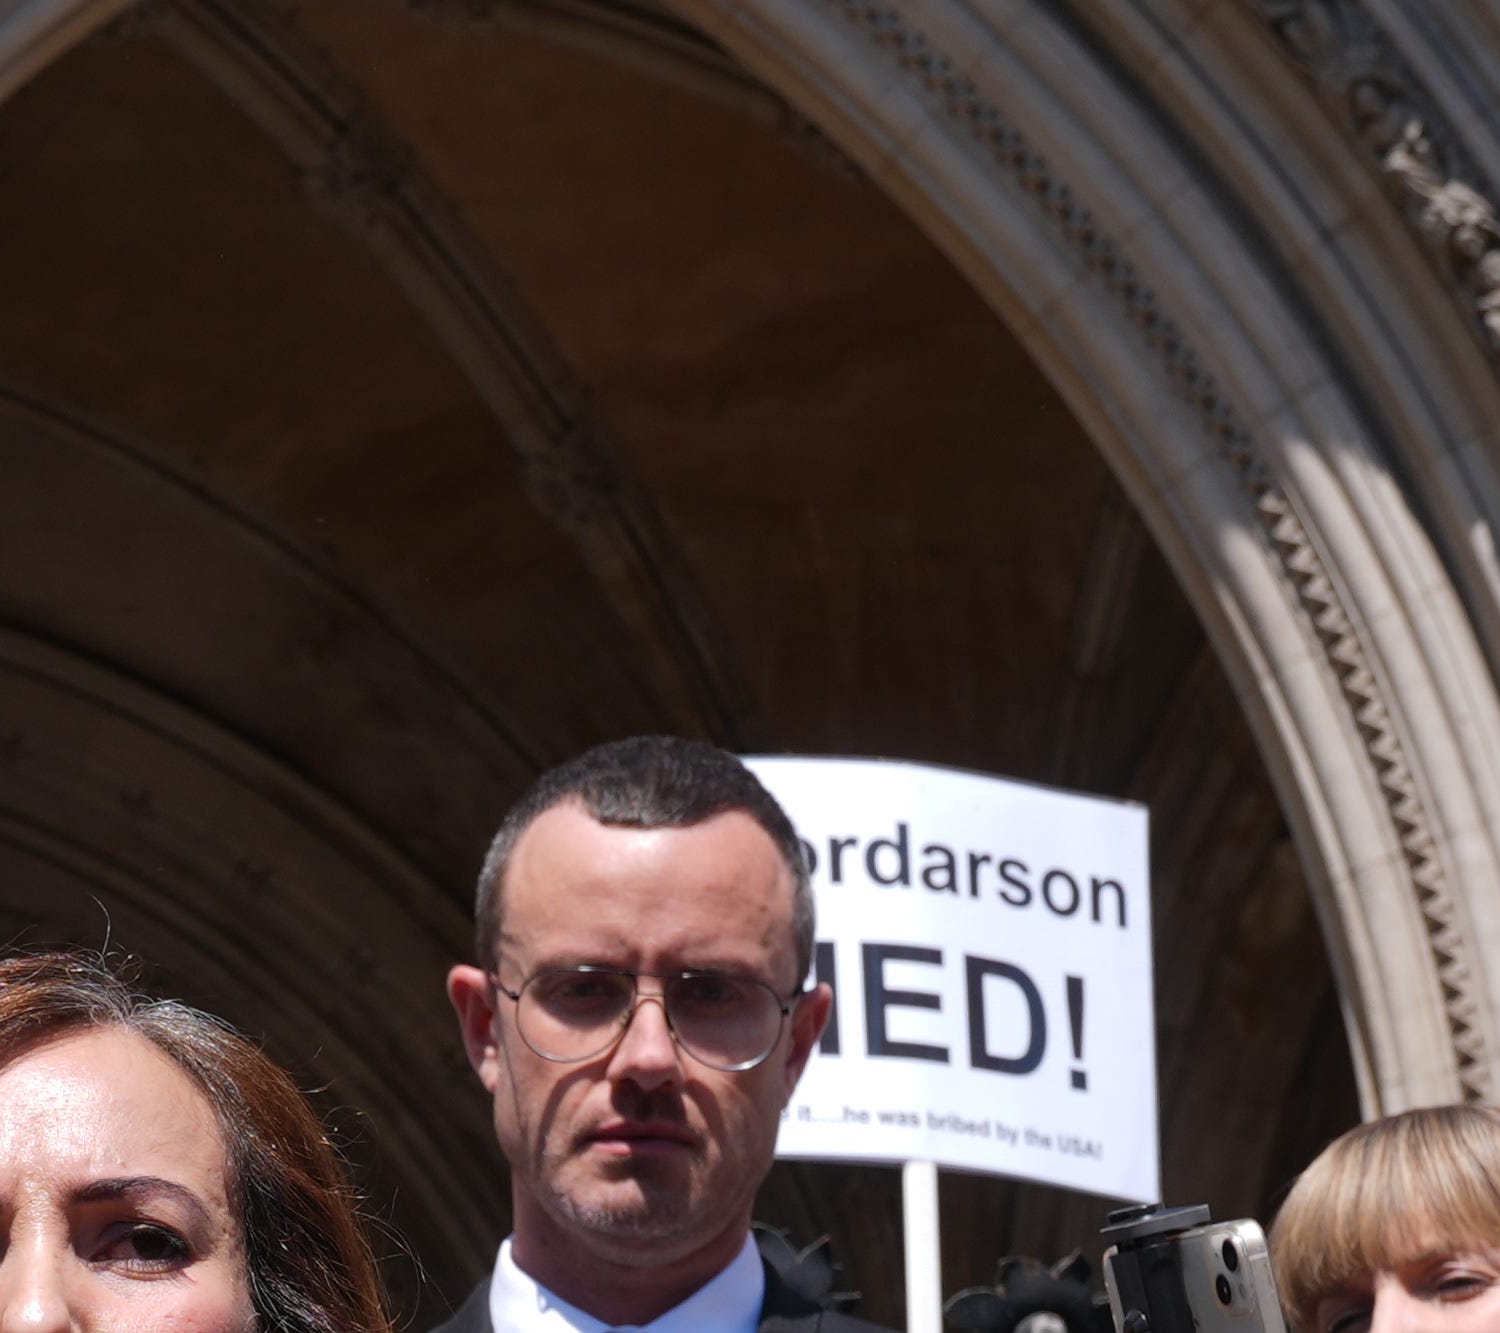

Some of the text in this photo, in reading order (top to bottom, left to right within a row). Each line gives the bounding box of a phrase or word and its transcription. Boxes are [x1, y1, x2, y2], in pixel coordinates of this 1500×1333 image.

[799, 821, 1130, 930] rdarson
[814, 940, 1089, 1093] IED!
[876, 1111, 921, 1128] was
[926, 1110, 991, 1138] bribed
[995, 1122, 1018, 1148] by
[1024, 1128, 1052, 1149] the
